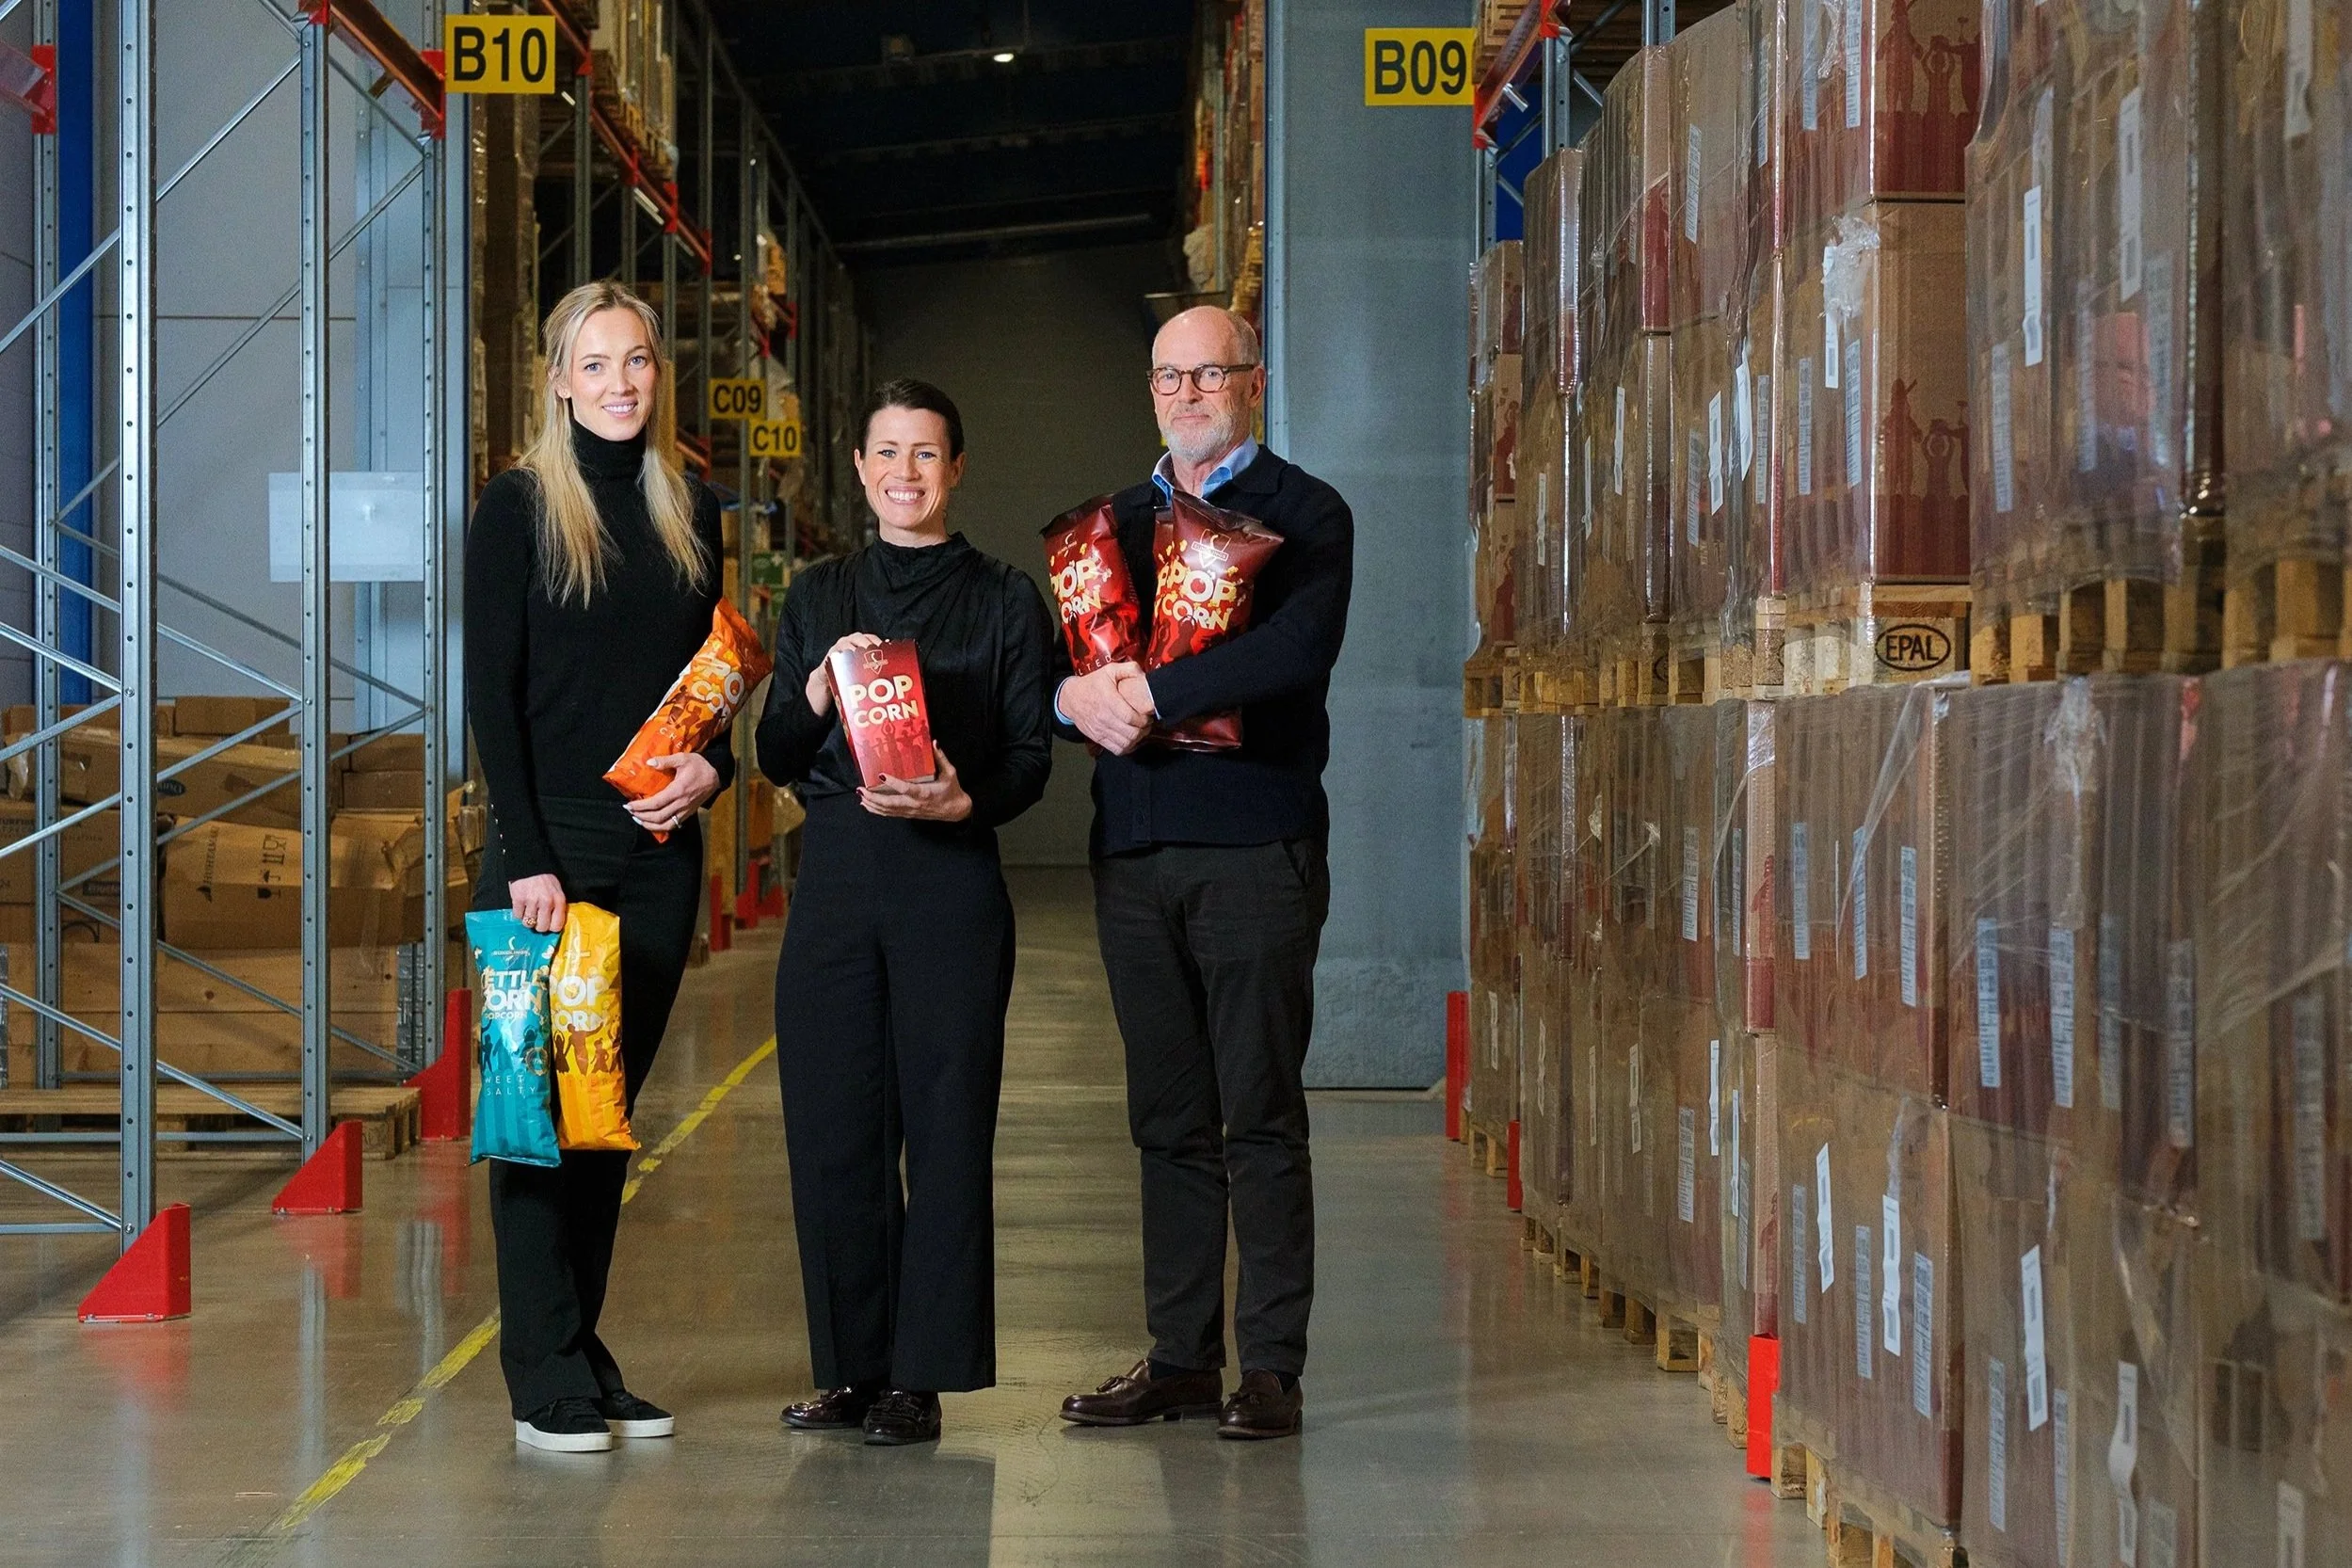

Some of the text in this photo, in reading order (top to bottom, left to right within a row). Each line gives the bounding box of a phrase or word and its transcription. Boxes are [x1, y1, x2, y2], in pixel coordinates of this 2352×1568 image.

[454, 26, 548, 83] B10
[1374, 40, 1466, 95] B09
[713, 384, 761, 413] C09
[754, 425, 797, 452] C10
[1167, 556, 1238, 607] POP
[1061, 584, 1101, 624] ORN
[1161, 593, 1234, 632] CORN
[1885, 634, 1940, 662] EPAL
[1075, 655, 1112, 677] LTED
[848, 674, 913, 709] POP
[853, 699, 920, 728] CORN
[485, 1075, 524, 1084] WEET
[486, 1086, 536, 1096] SALTY
